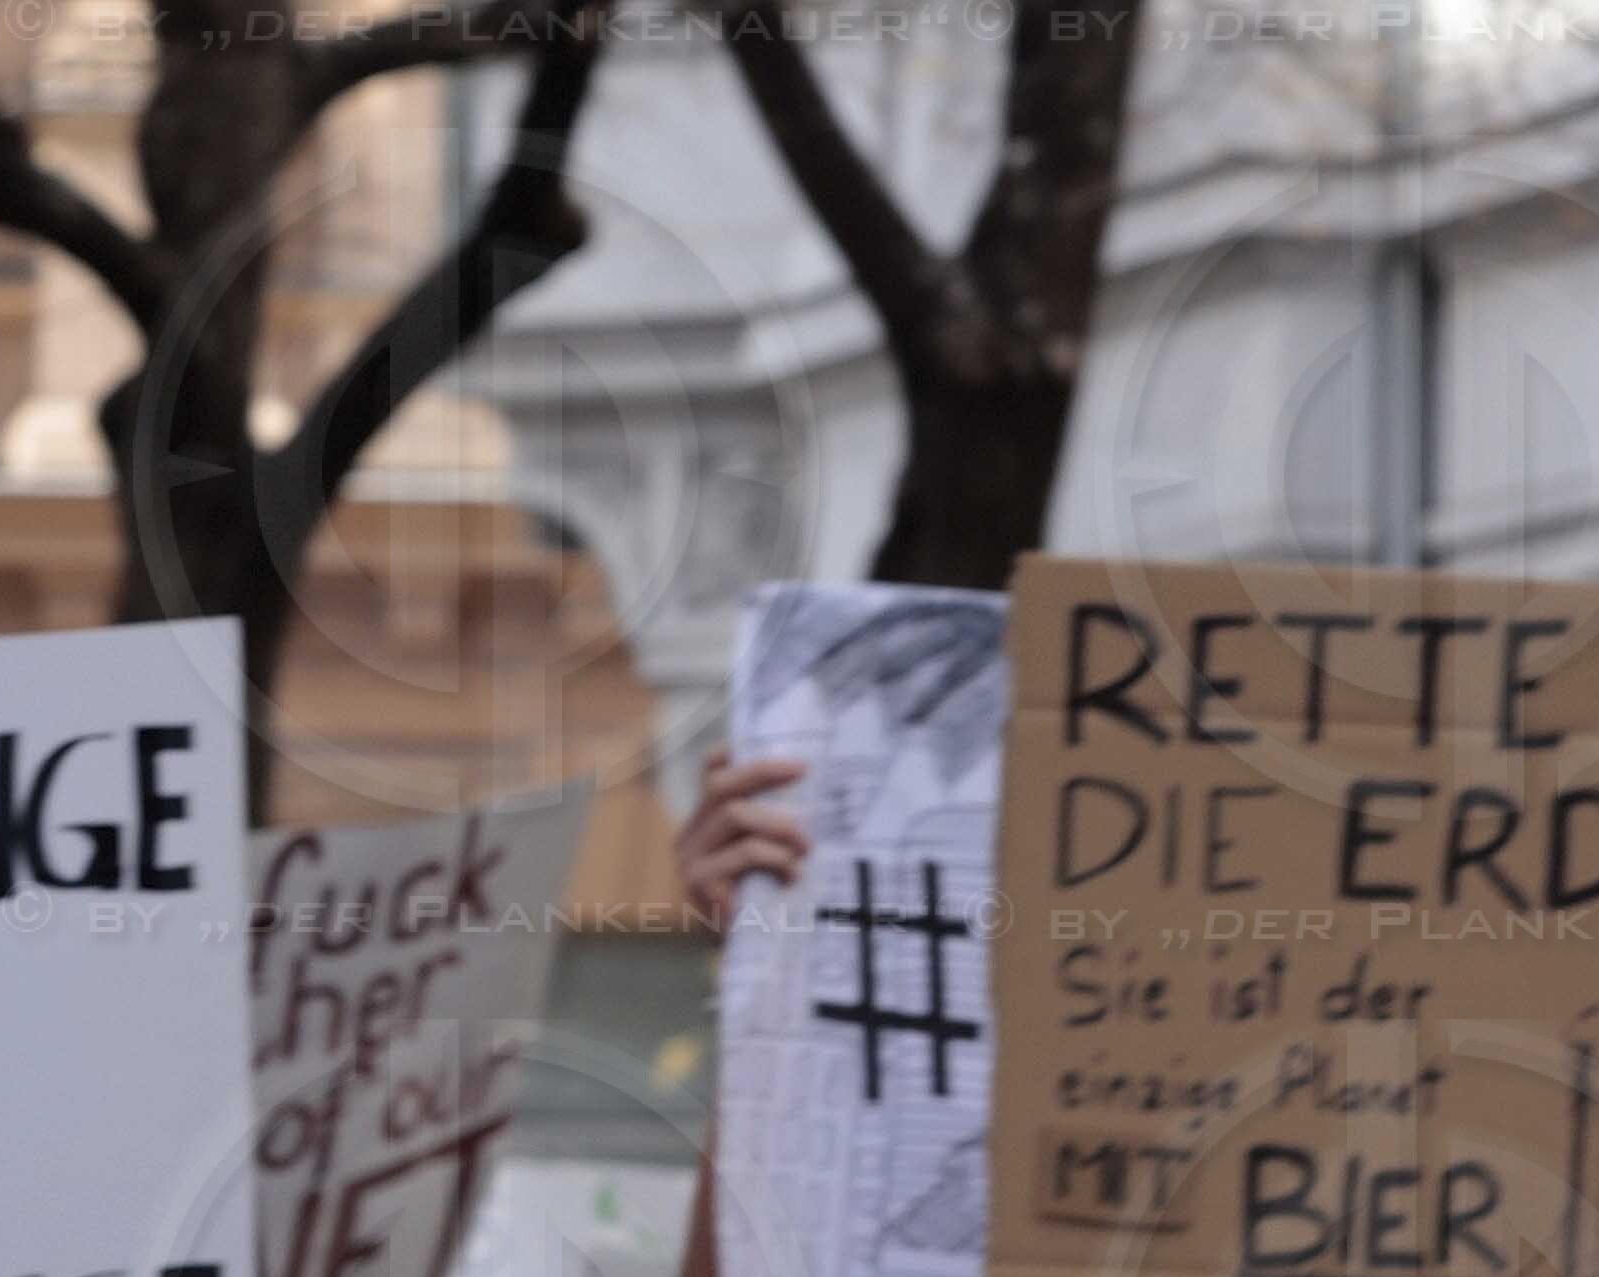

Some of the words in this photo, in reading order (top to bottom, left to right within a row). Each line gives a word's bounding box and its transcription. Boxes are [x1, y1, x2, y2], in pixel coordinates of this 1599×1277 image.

[1053, 777, 1280, 897] DIE
[251, 950, 466, 1078] her
[815, 860, 980, 1103] #
[1058, 944, 1168, 1027] Sie
[1210, 943, 1288, 1022] ist
[1321, 951, 1434, 1022] der
[1242, 1142, 1508, 1272] BIER
